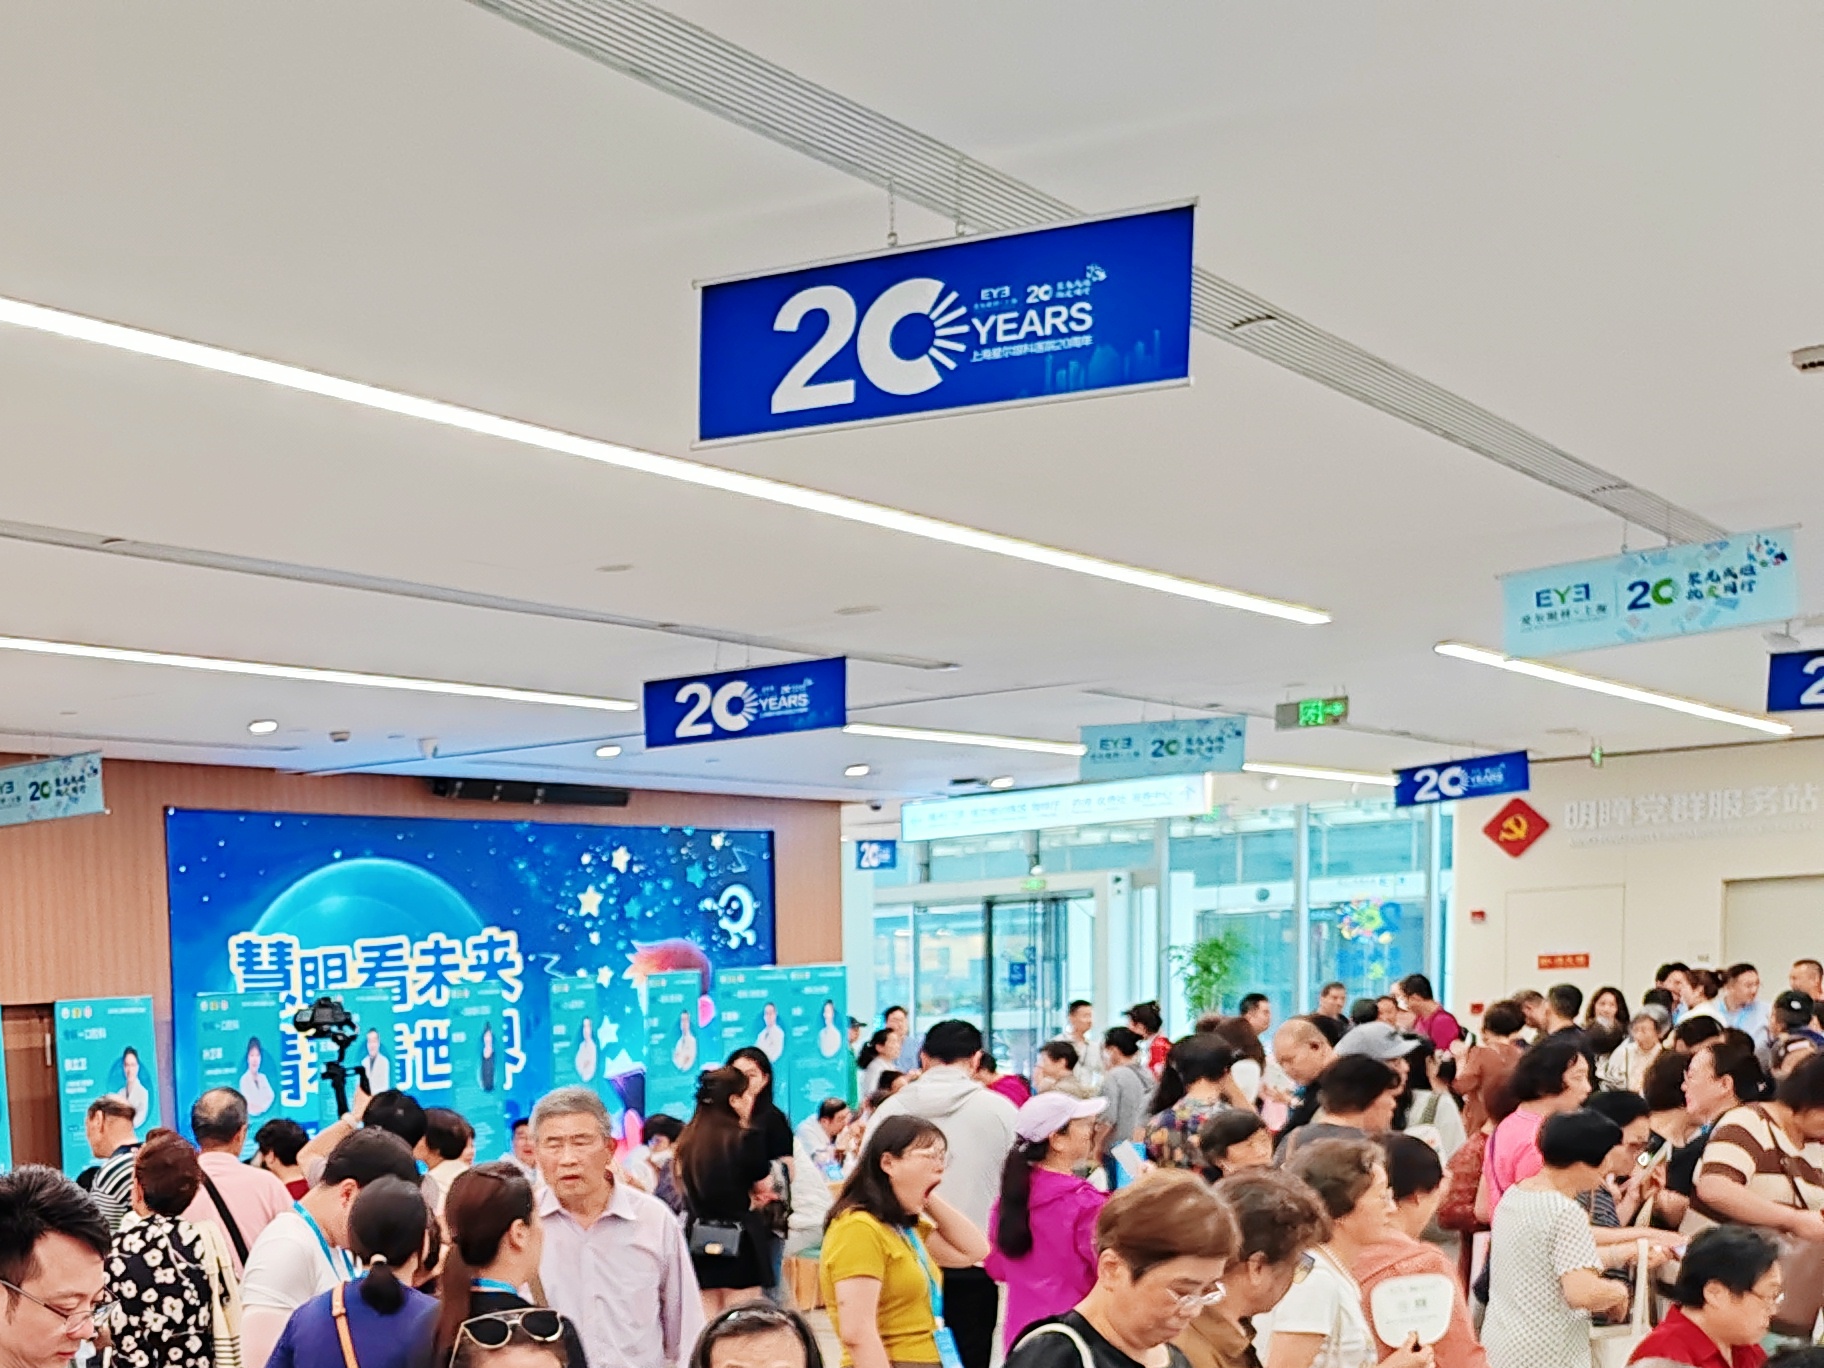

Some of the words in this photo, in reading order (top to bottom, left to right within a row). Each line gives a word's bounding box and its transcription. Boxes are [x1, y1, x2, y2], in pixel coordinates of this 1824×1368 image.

[971, 301, 1093, 345] YEARS
[771, 277, 958, 414] 20
[1627, 578, 1678, 611] 20
[675, 680, 754, 738] 20
[759, 693, 809, 711] YEARS
[1414, 766, 1465, 802] 20
